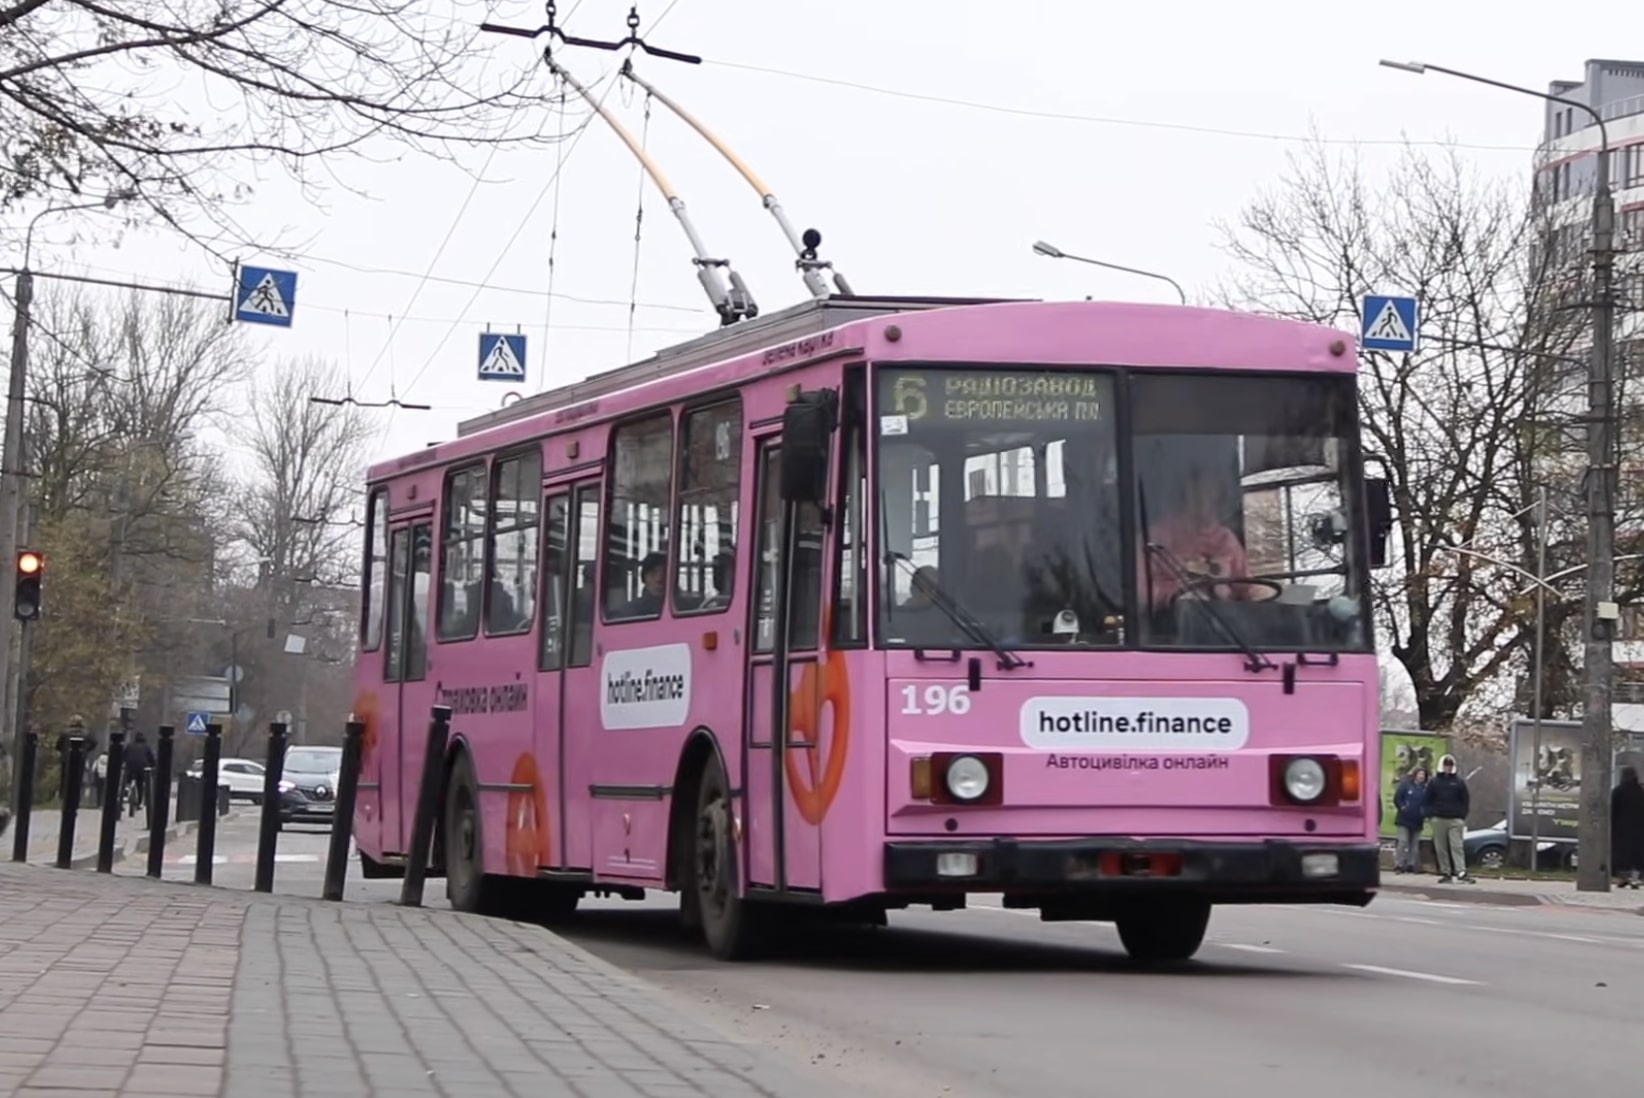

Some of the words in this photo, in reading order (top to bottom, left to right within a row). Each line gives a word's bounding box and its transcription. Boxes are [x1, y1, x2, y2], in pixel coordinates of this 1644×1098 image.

[894, 377, 928, 420] 6
[607, 669, 683, 704] hotline.finance
[901, 685, 971, 715] 196
[1039, 711, 1232, 733] hotline.finance
[1046, 753, 1159, 770] Автоцивілка
[1162, 754, 1229, 770] онлайн
